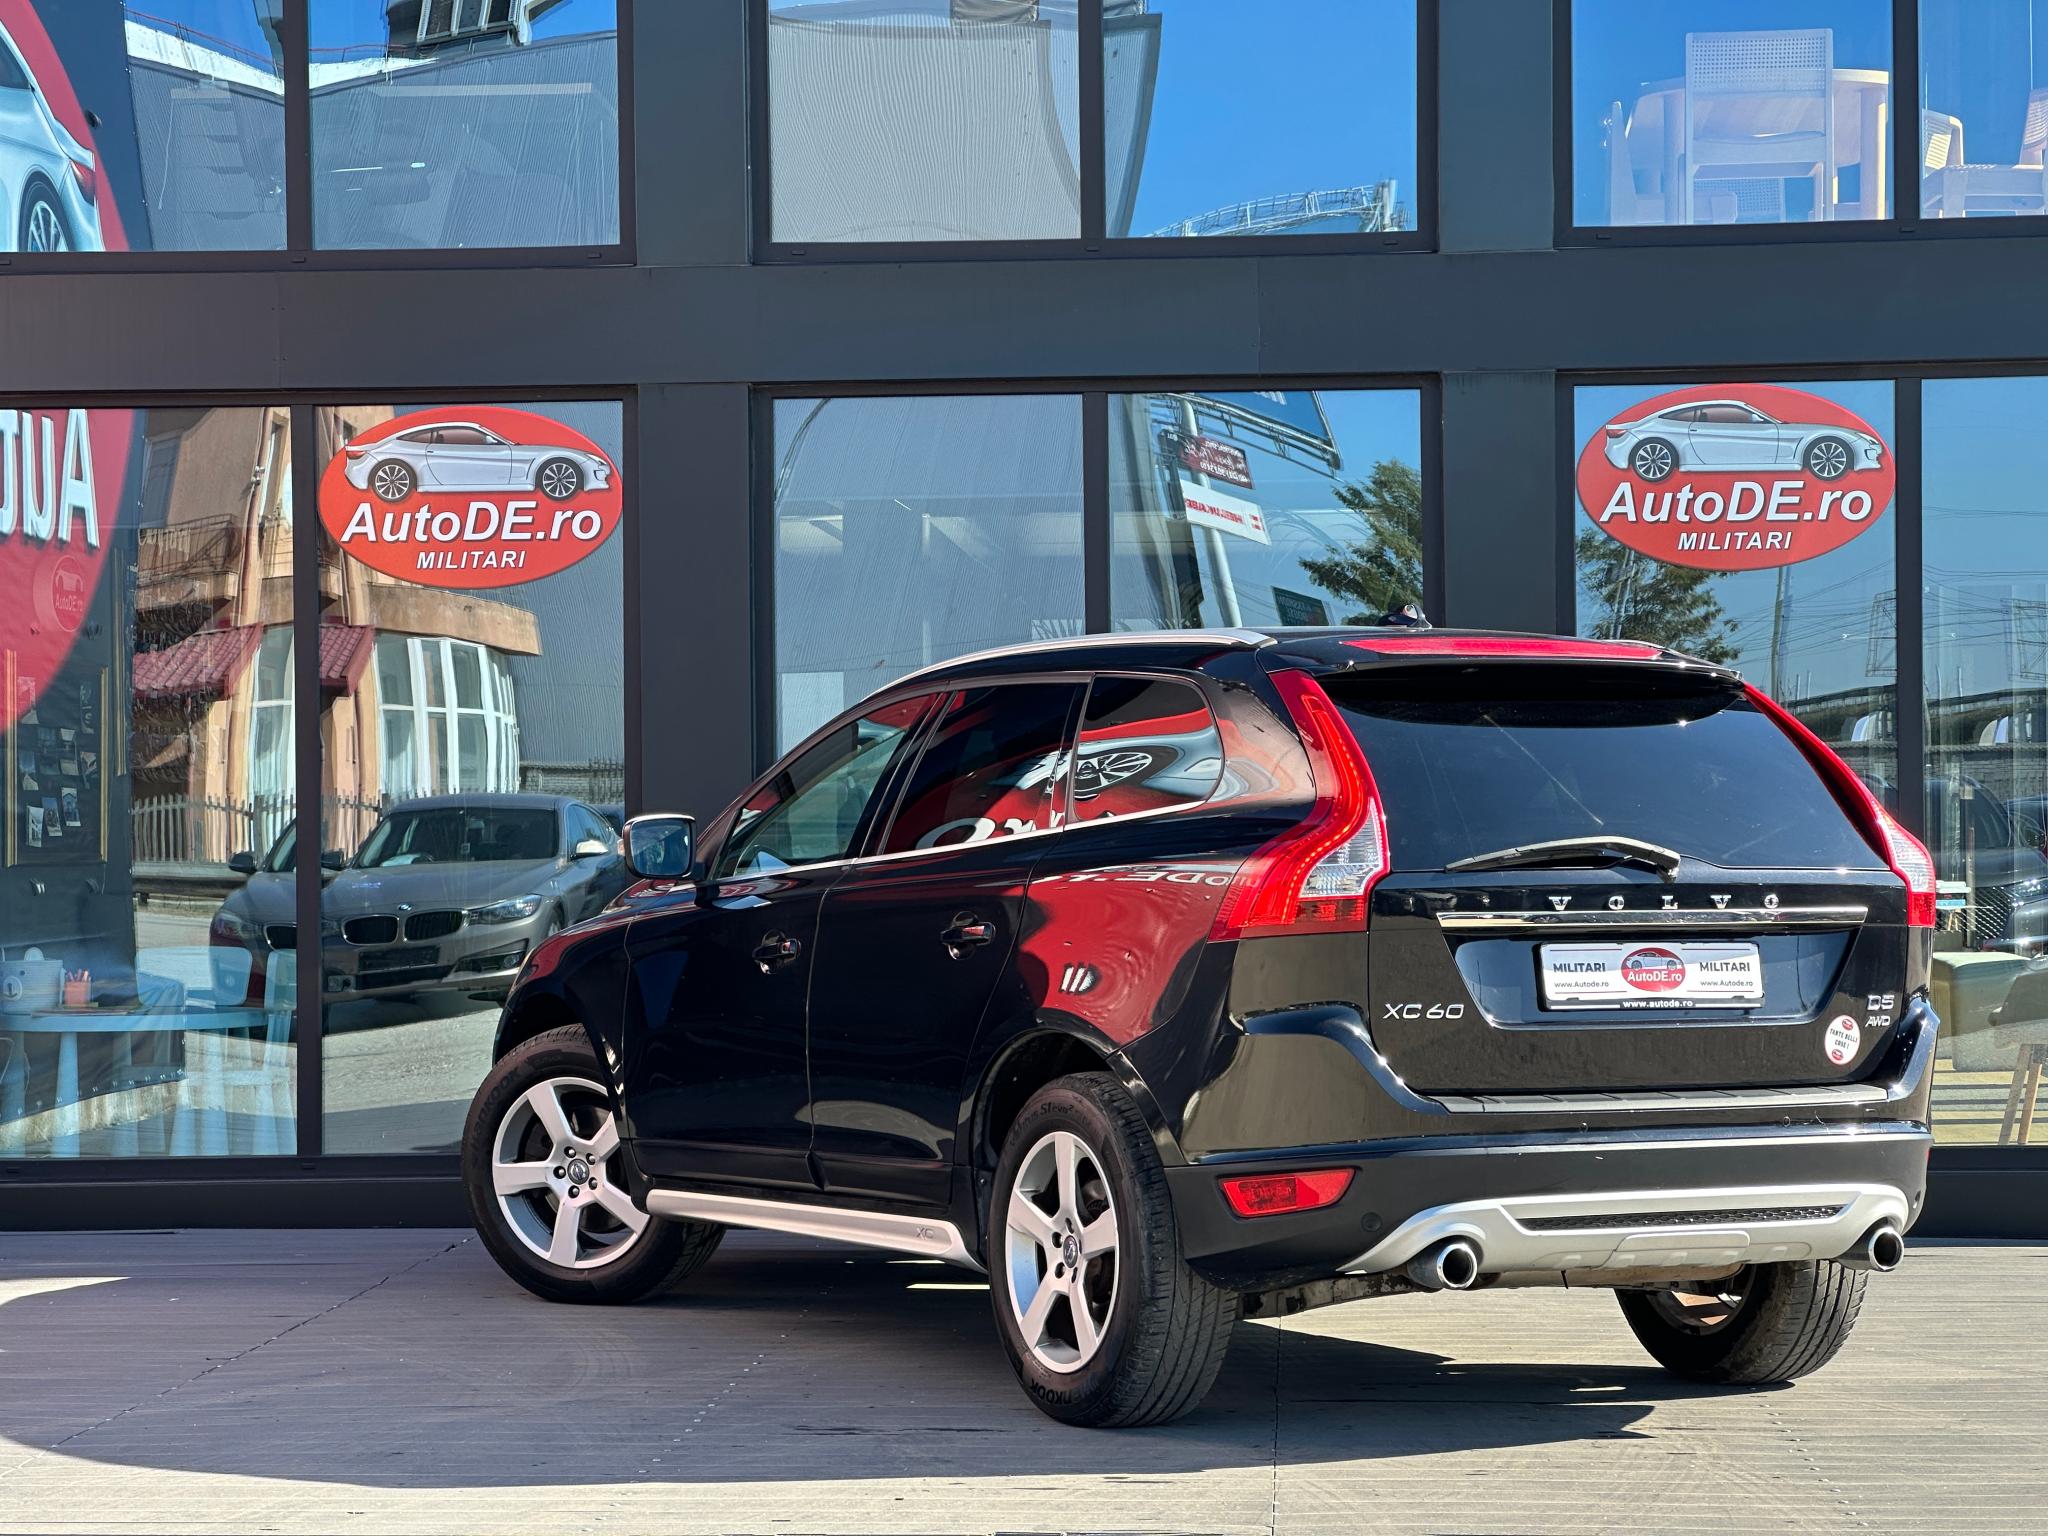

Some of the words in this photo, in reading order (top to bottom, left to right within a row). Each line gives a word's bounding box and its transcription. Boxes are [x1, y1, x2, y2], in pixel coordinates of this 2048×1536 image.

[1599, 480, 1872, 523] AutoDE.ro
[340, 500, 602, 543] AutoDE.ro
[1677, 531, 1793, 551] MILITARI
[416, 550, 526, 570] MILITARI
[1548, 894, 1780, 911] VOLVO
[1553, 962, 1606, 973] MILITARI
[1699, 962, 1751, 972] MILITARI
[1626, 970, 1683, 982] AutoDE.ro
[1554, 980, 1610, 988] www.Autode.ro
[1700, 979, 1754, 987] www.Autode.ro
[1622, 999, 1694, 1009] www.autode.ro
[1867, 994, 1895, 1011] D5
[1865, 1015, 1891, 1028] AWD
